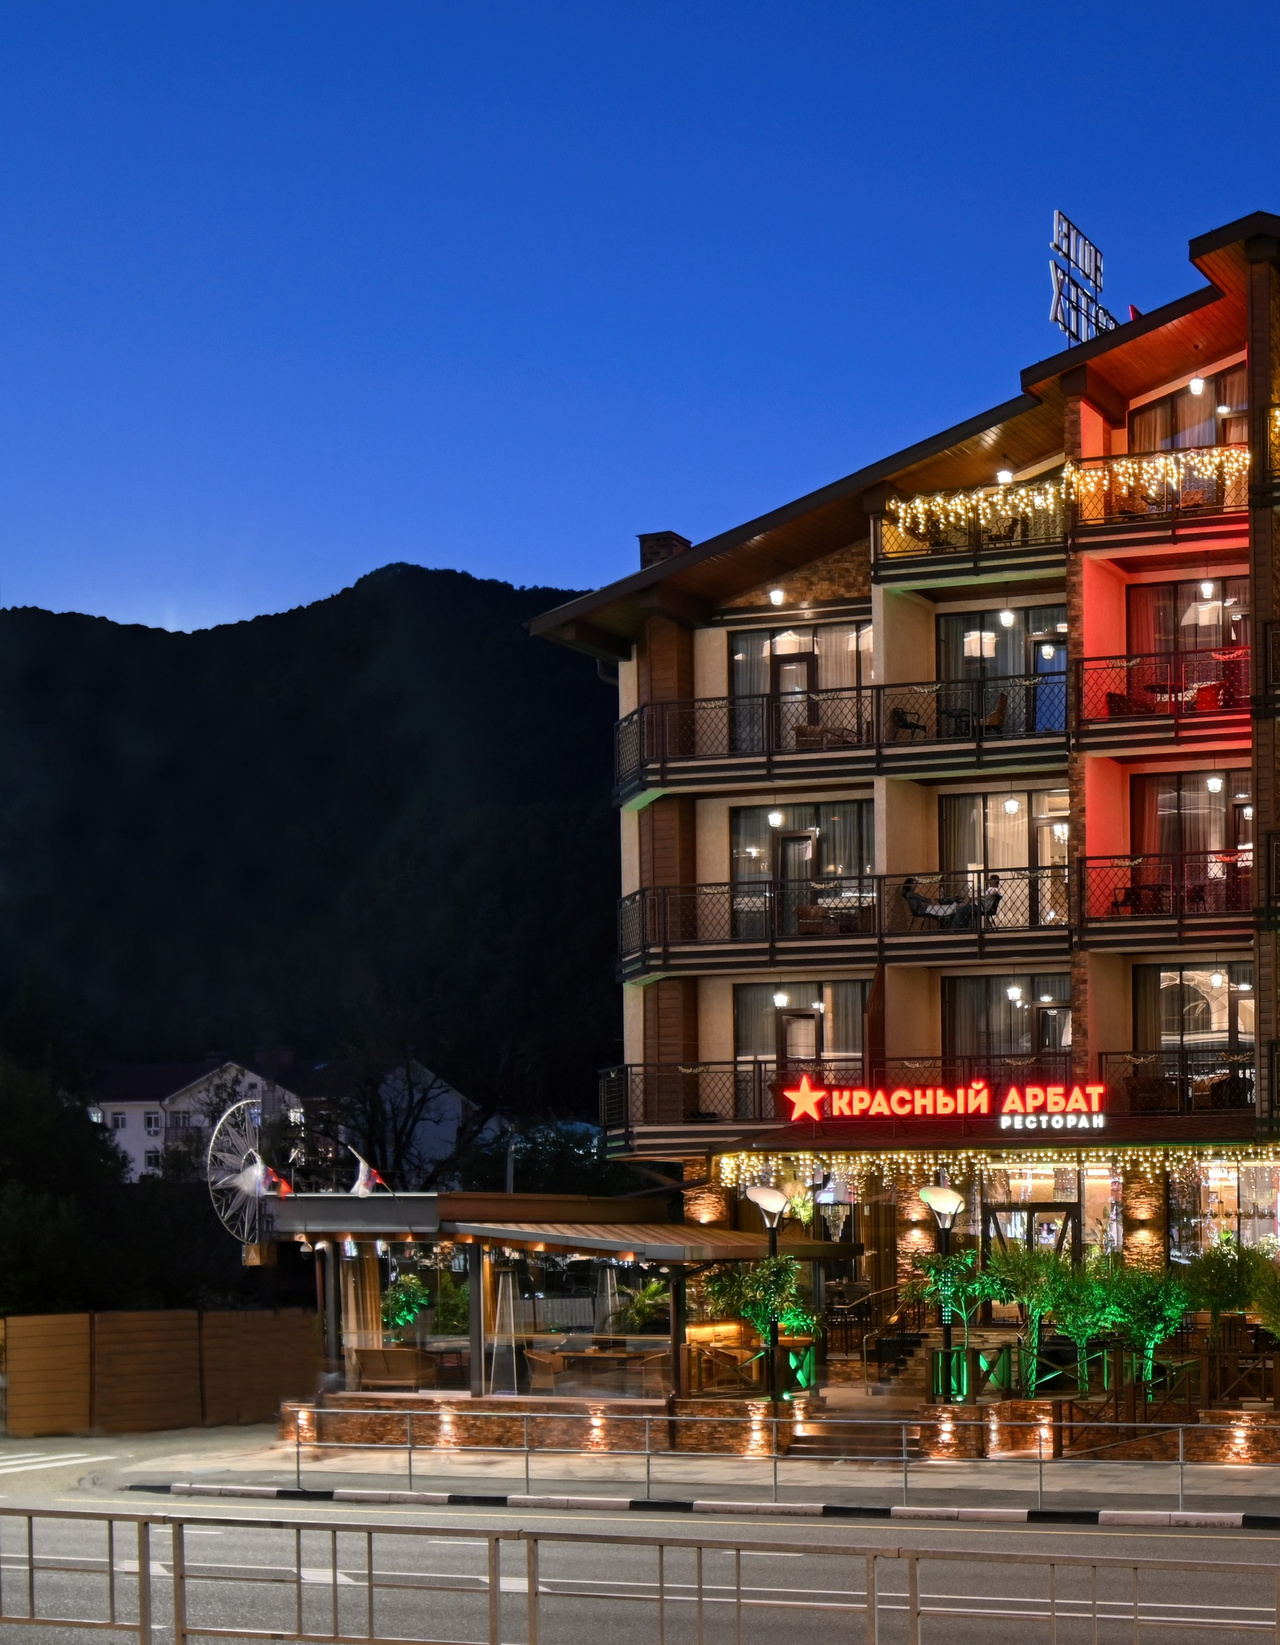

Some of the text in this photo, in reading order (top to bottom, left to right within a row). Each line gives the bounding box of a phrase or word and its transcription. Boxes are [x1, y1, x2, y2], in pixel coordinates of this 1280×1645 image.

[832, 1082, 1104, 1115] КРАСНЫЙ АРБАТ
[1001, 1115, 1104, 1129] РЕСТОРАН
